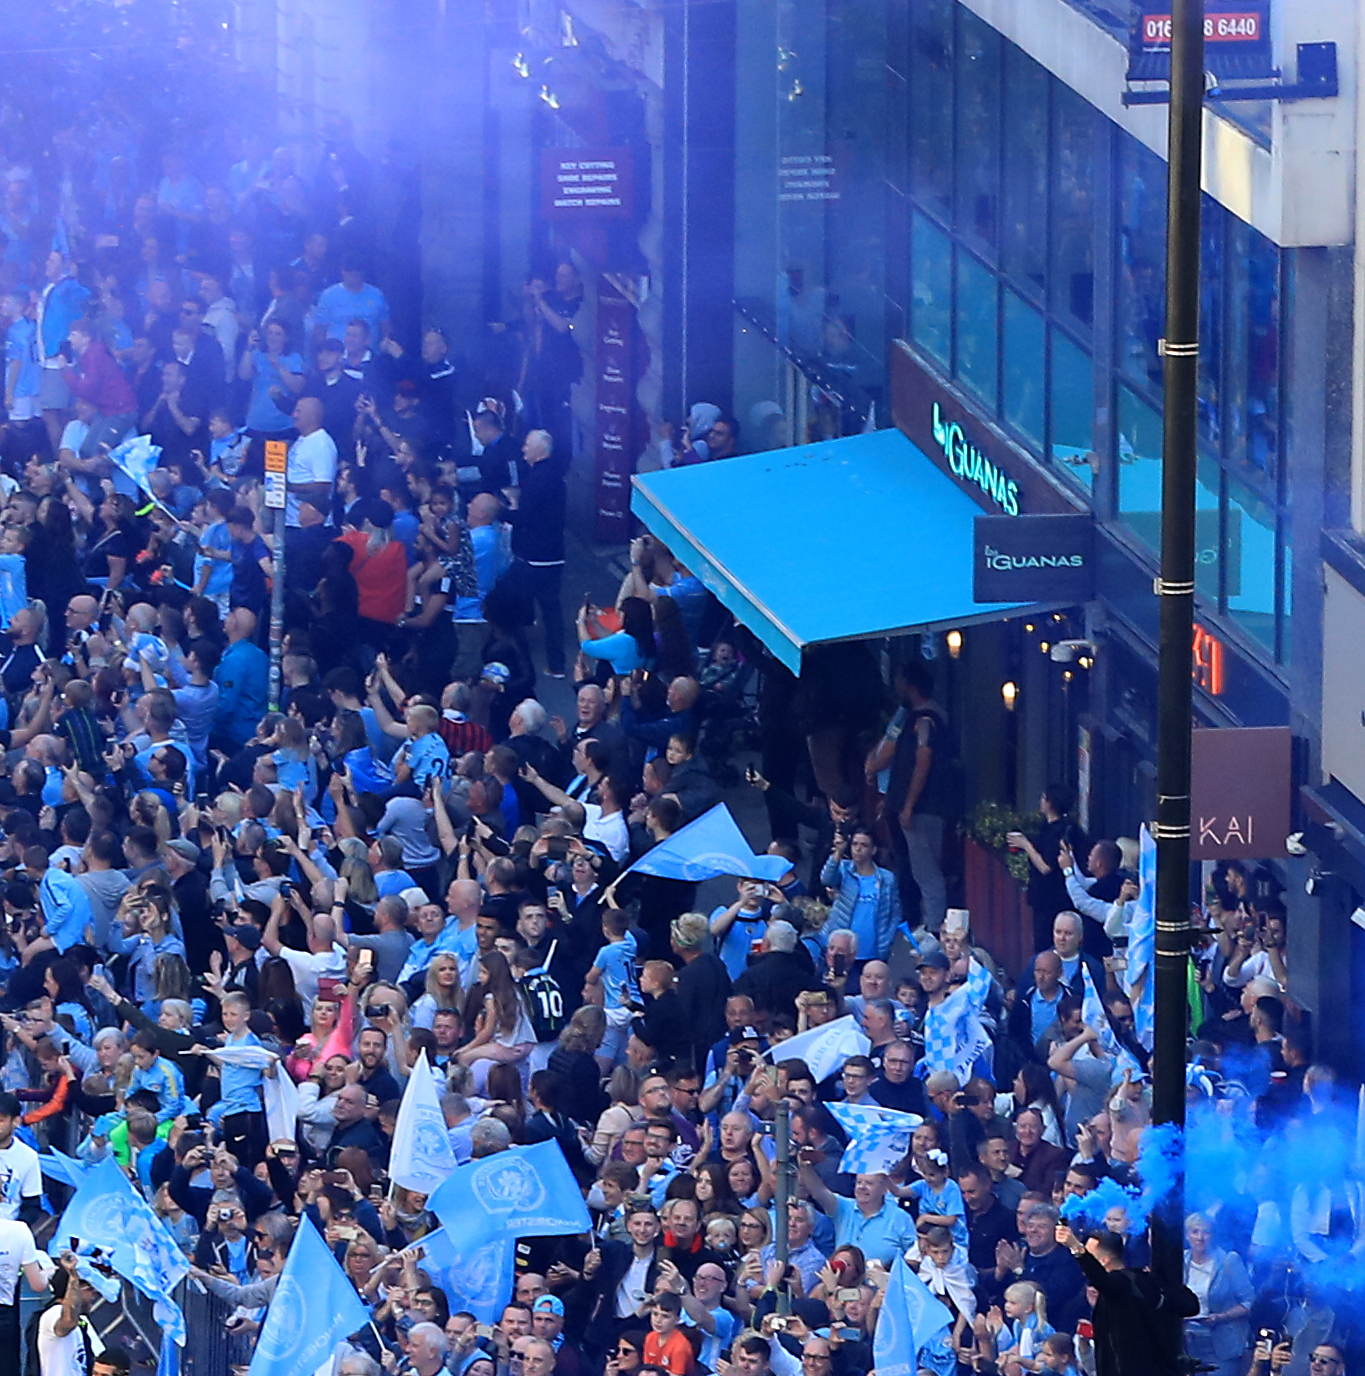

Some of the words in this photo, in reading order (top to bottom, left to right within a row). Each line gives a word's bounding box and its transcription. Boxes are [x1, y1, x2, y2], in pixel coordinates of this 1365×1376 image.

[1146, 20, 1172, 37] 016
[1218, 18, 1256, 36] 6440
[1199, 815, 1253, 845] KAI
[537, 990, 563, 1018] 10
